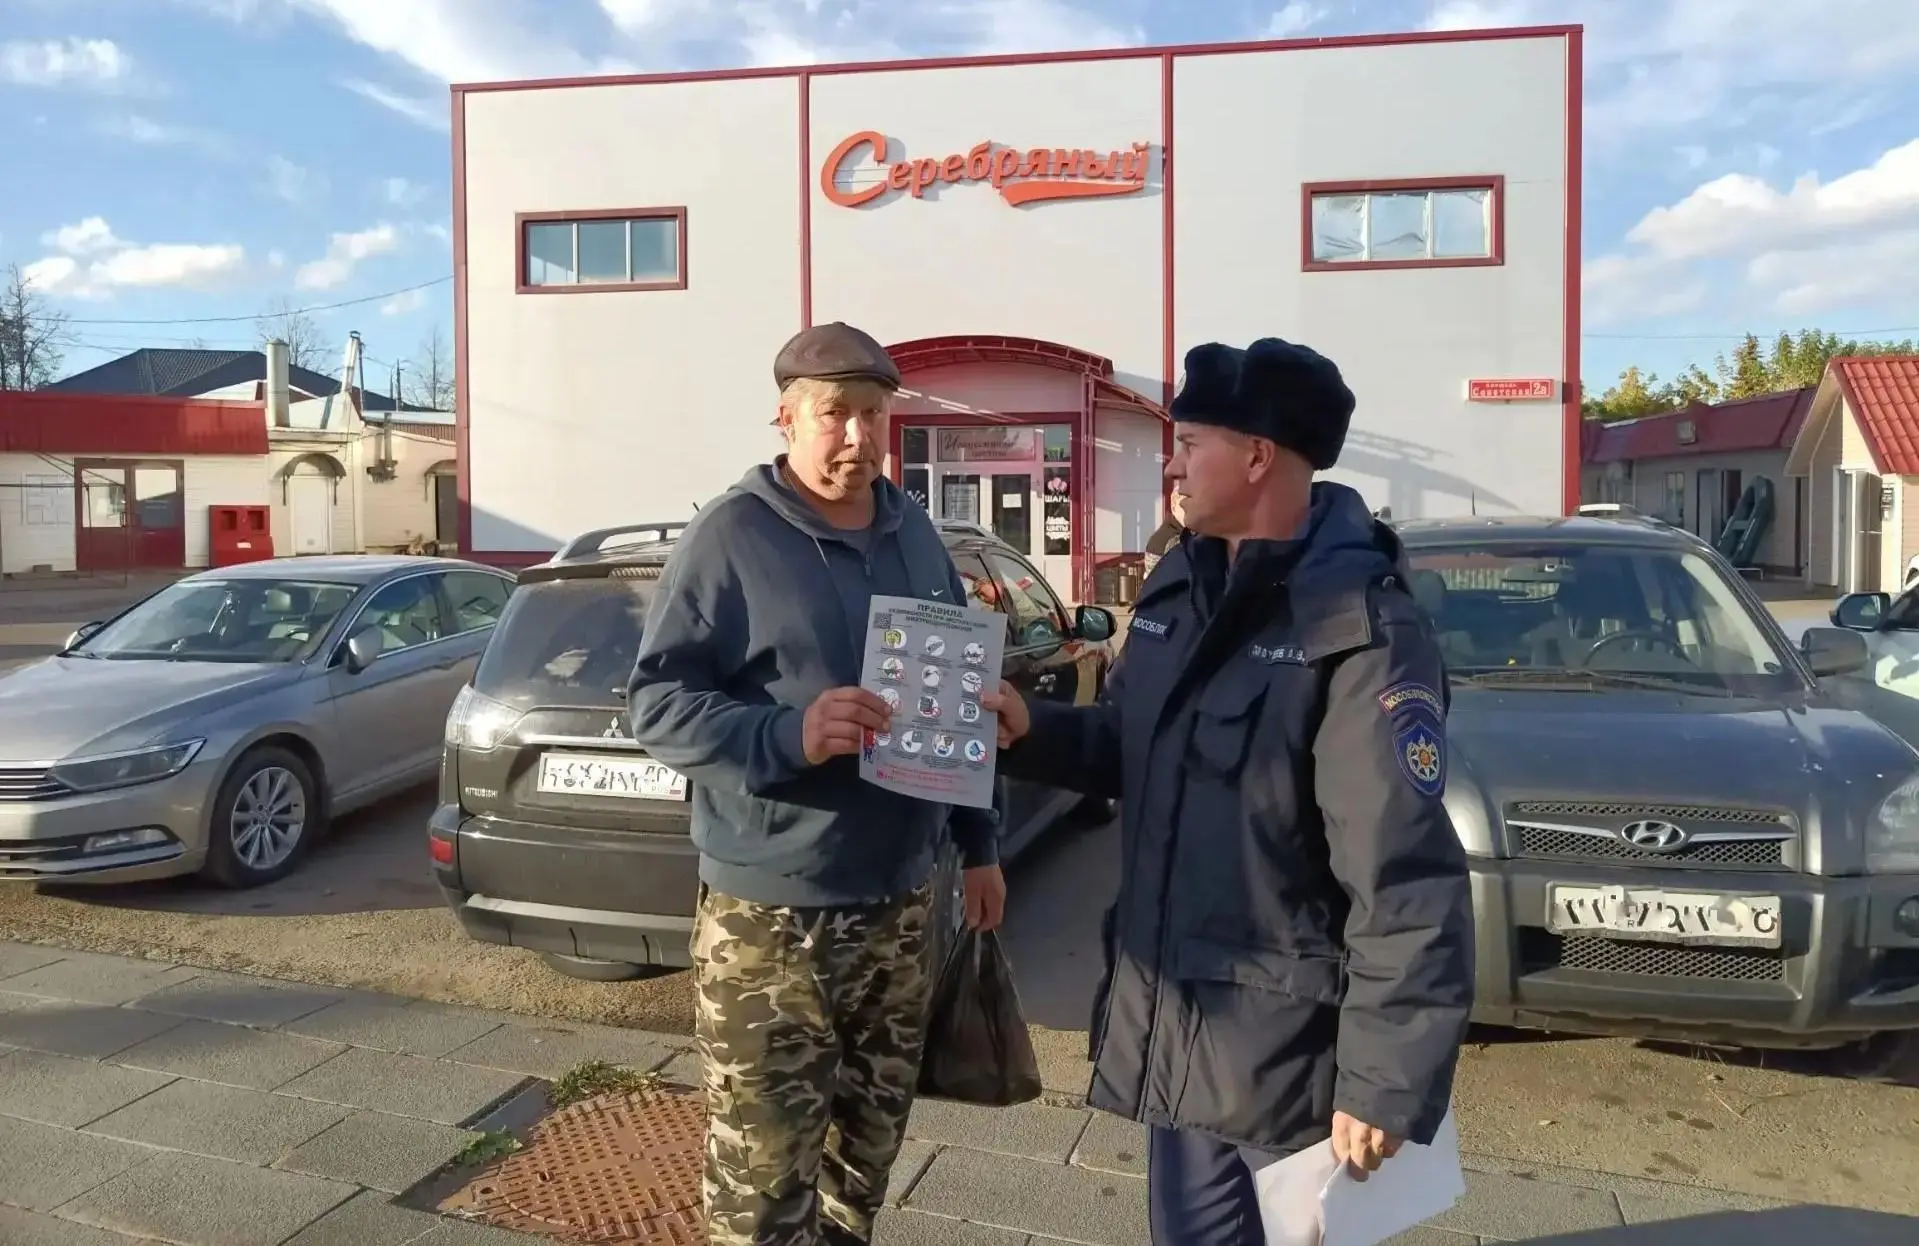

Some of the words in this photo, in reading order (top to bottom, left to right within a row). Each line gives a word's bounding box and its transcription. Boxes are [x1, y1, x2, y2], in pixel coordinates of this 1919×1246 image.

[820, 131, 1150, 207] Серебряный
[917, 603, 964, 618] ПРАВИЛА
[464, 787, 498, 799] MITSUBISHI
